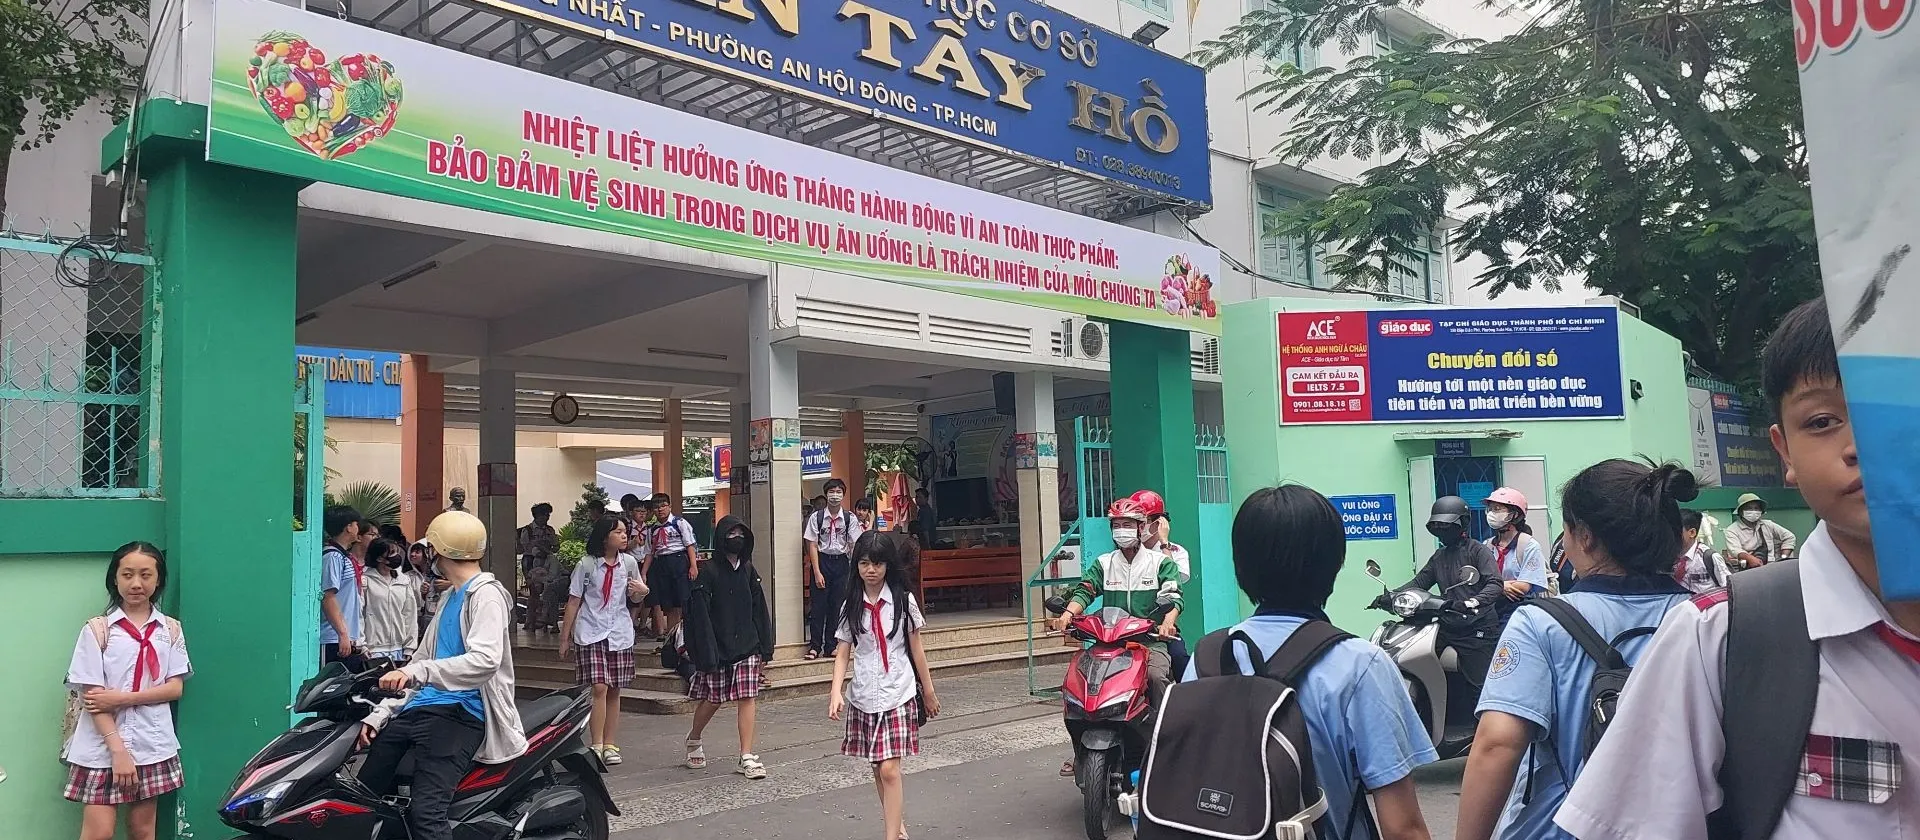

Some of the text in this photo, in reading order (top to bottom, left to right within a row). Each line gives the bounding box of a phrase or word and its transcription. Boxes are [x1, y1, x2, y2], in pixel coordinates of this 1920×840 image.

[1006, 11, 1052, 50] CƠ
[1058, 27, 1098, 68] SỞ
[568, 0, 645, 31] NHẤT
[669, 21, 774, 70] PHƯỜNG
[781, 57, 811, 82] AN
[818, 67, 854, 96] HỘI
[860, 82, 917, 114] ĐÔNG
[932, 102, 998, 137] TP.HCM
[837, 0, 1180, 154] TÂY HỒ
[523, 110, 1119, 270] NHIỆT LIỆT HƯỞNG ỨNG THÁNG HÀNH ĐỘNG VÌ AN TOÀN THỰC PHẨM:
[428, 135, 1157, 309] BẢO ĐẢM VỆ SINH TRONG DỊCH VỤ ĂN UỐNG LÀ TRÁCH NHIỆM CỦA MỖI CHÚNG TA
[1307, 319, 1336, 336] ACE
[1381, 321, 1431, 335] giáo dục
[1456, 319, 1470, 327] CHÍ
[1510, 318, 1536, 326] THÀNH
[1538, 317, 1554, 325] PHỐ
[1556, 317, 1567, 325] HỒ
[1568, 317, 1582, 325] CHÍ
[1282, 344, 1291, 356] HỆ
[1291, 343, 1313, 354] THỐNG
[1314, 345, 1328, 354] ANH
[1329, 343, 1343, 353] NGỮ
[1427, 348, 1558, 369] Chuyển đổi số
[329, 352, 354, 383] DÂN
[356, 354, 374, 384] TRÍ
[1292, 372, 1311, 380] CAM
[1313, 370, 1327, 380] KẾT
[1348, 371, 1359, 379] RA
[1307, 382, 1345, 392] IELTS 7.5
[1398, 375, 1587, 393] Hướng tới một nền giáo dục
[1293, 400, 1346, 408] 0901.08.18.18
[1388, 392, 1603, 411] tiên tiến và phát triển bền vững
[1342, 499, 1381, 510] VUI LÒNG
[1341, 511, 1393, 524] ÔNG ĐẬU XE
[1344, 521, 1390, 535] ƯỚC CỔNG
